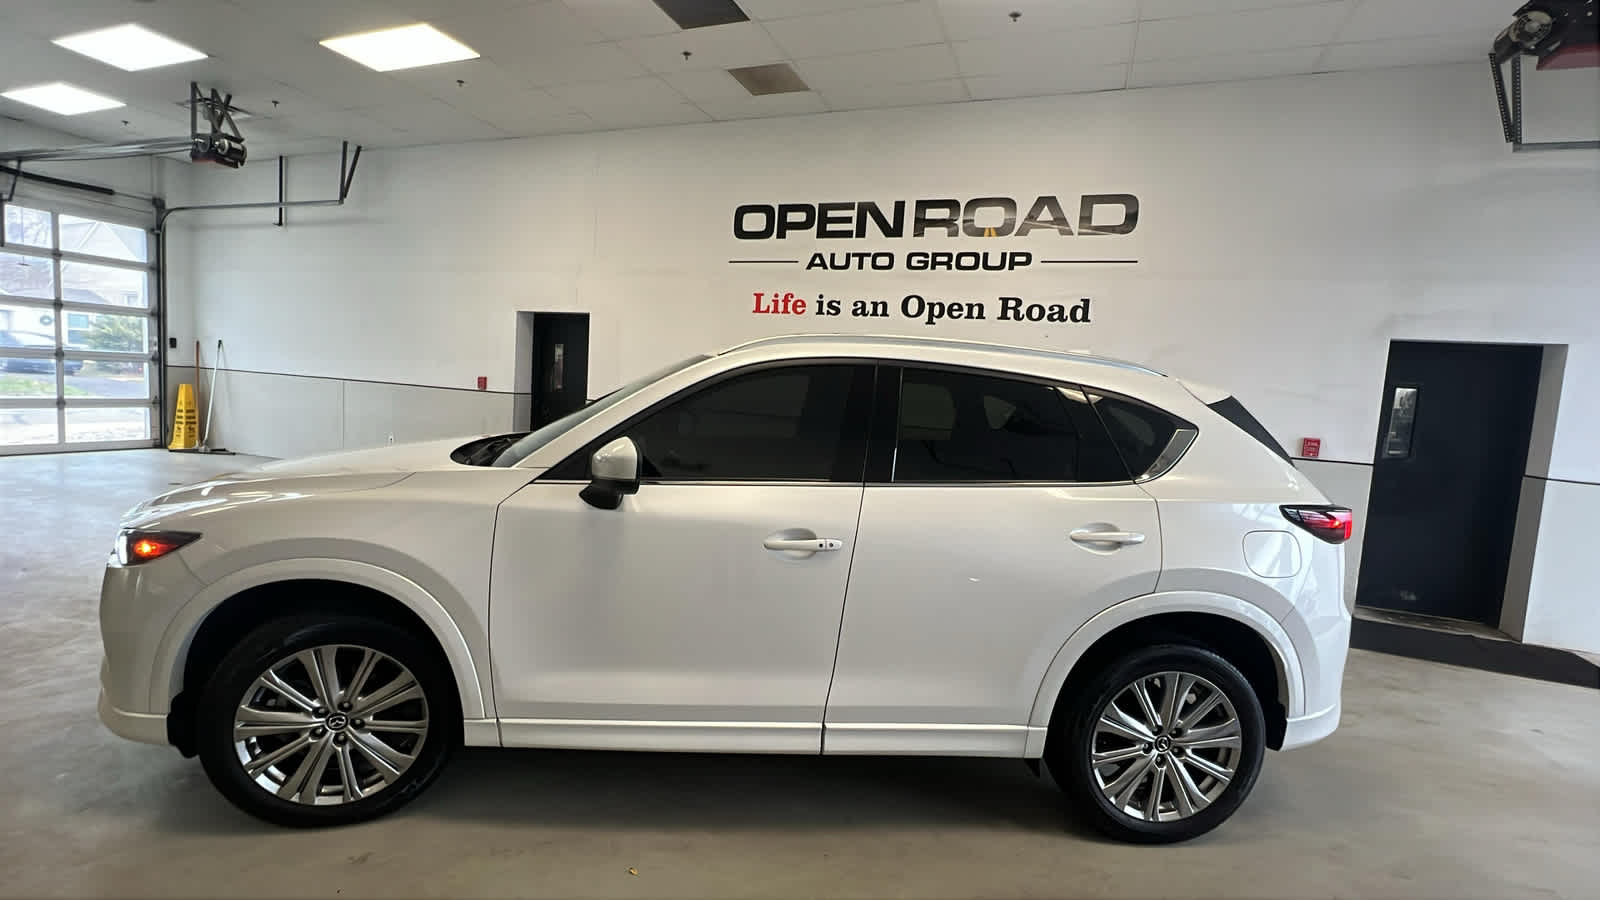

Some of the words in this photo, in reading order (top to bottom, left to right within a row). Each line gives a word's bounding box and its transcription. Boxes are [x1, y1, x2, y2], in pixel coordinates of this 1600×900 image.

[734, 200, 905, 239] OPEN
[913, 193, 1140, 238] ROAD
[806, 252, 895, 271] AUTO
[906, 251, 1033, 271] GROUP
[752, 293, 807, 315] Life
[816, 294, 842, 316] is
[852, 300, 890, 318] an
[901, 294, 986, 325] Open
[997, 296, 1091, 323] Road
